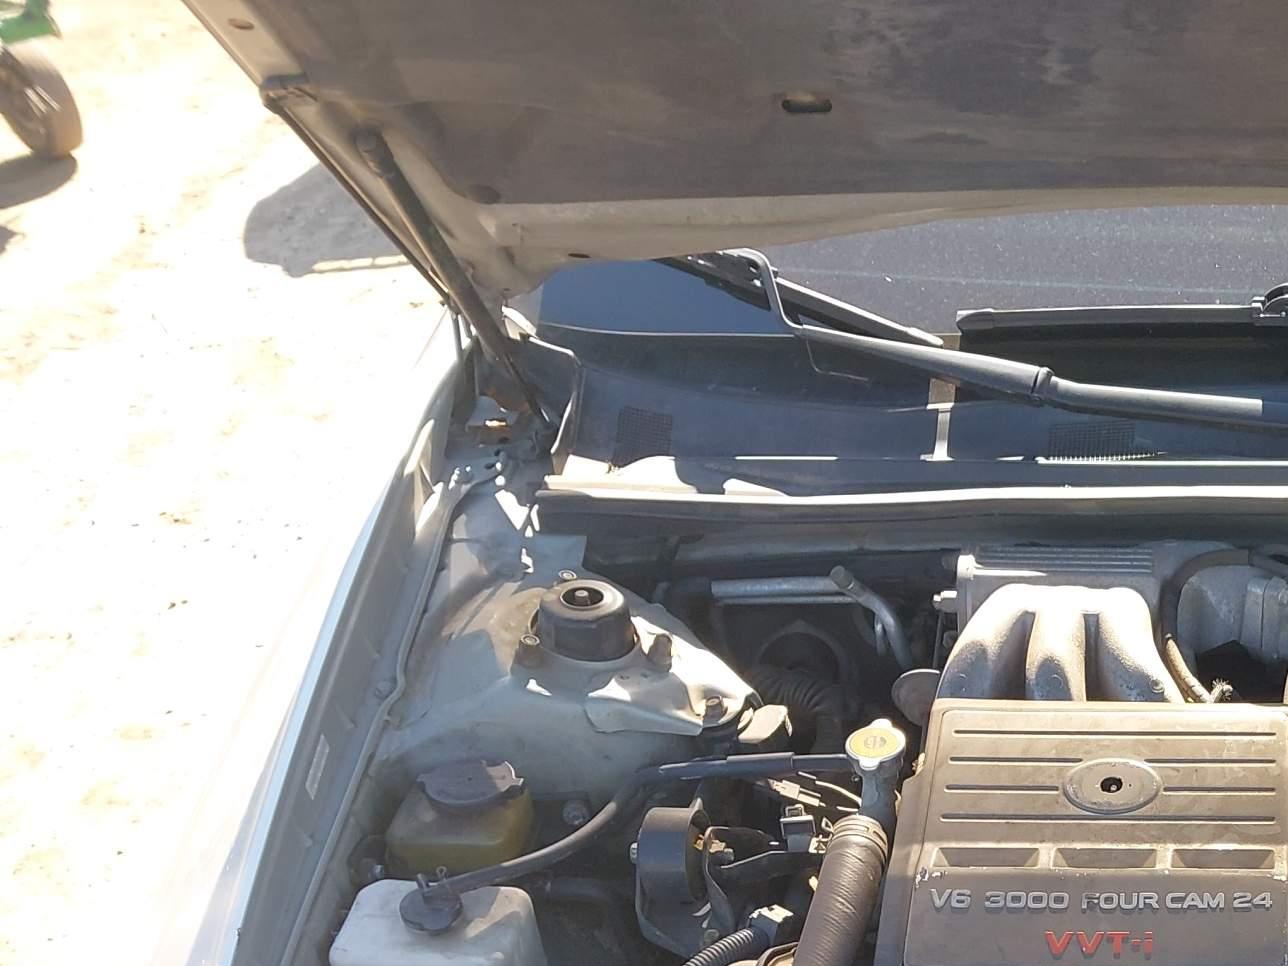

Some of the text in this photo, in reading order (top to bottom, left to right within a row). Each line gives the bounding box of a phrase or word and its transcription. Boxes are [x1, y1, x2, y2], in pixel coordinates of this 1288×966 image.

[930, 888, 1273, 910] V6 3000 FOUR CAM 24
[1044, 930, 1154, 958] VVT-i
